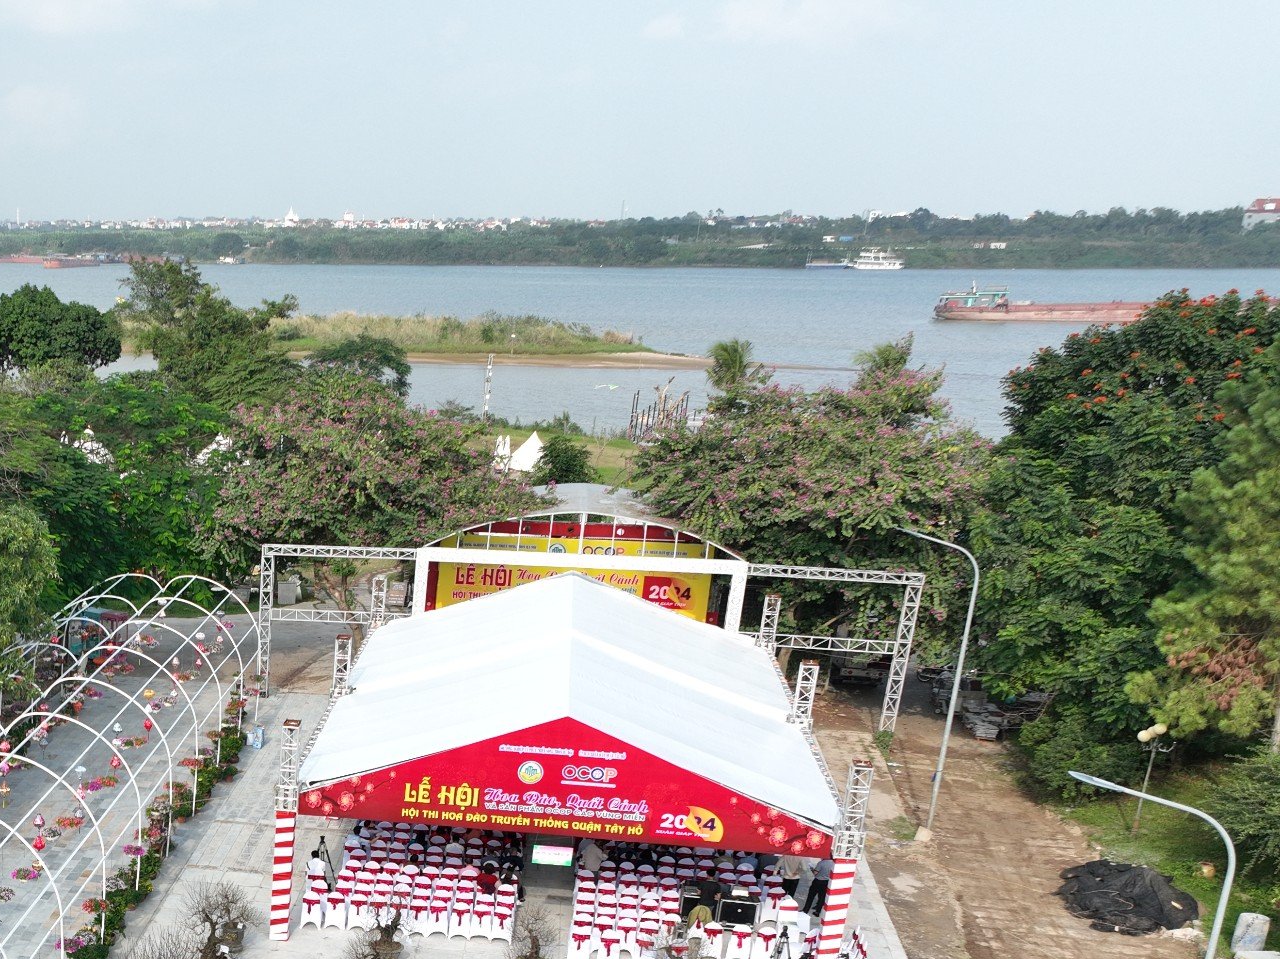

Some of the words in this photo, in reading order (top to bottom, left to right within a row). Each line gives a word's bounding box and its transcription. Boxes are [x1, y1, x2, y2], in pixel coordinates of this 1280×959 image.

[481, 564, 513, 591] HỘI
[561, 764, 618, 782] OCOP
[403, 776, 432, 804] LỄ
[437, 783, 480, 811] HỘI
[484, 787, 519, 803] Hoa
[566, 793, 605, 810] Quất
[607, 797, 650, 814] Cảnh
[401, 807, 419, 819] HỘI
[422, 809, 439, 819] THI
[441, 811, 463, 821] HOA
[571, 821, 602, 834] QUẬN
[604, 822, 626, 834] TÂY
[545, 808, 572, 816] OCOP
